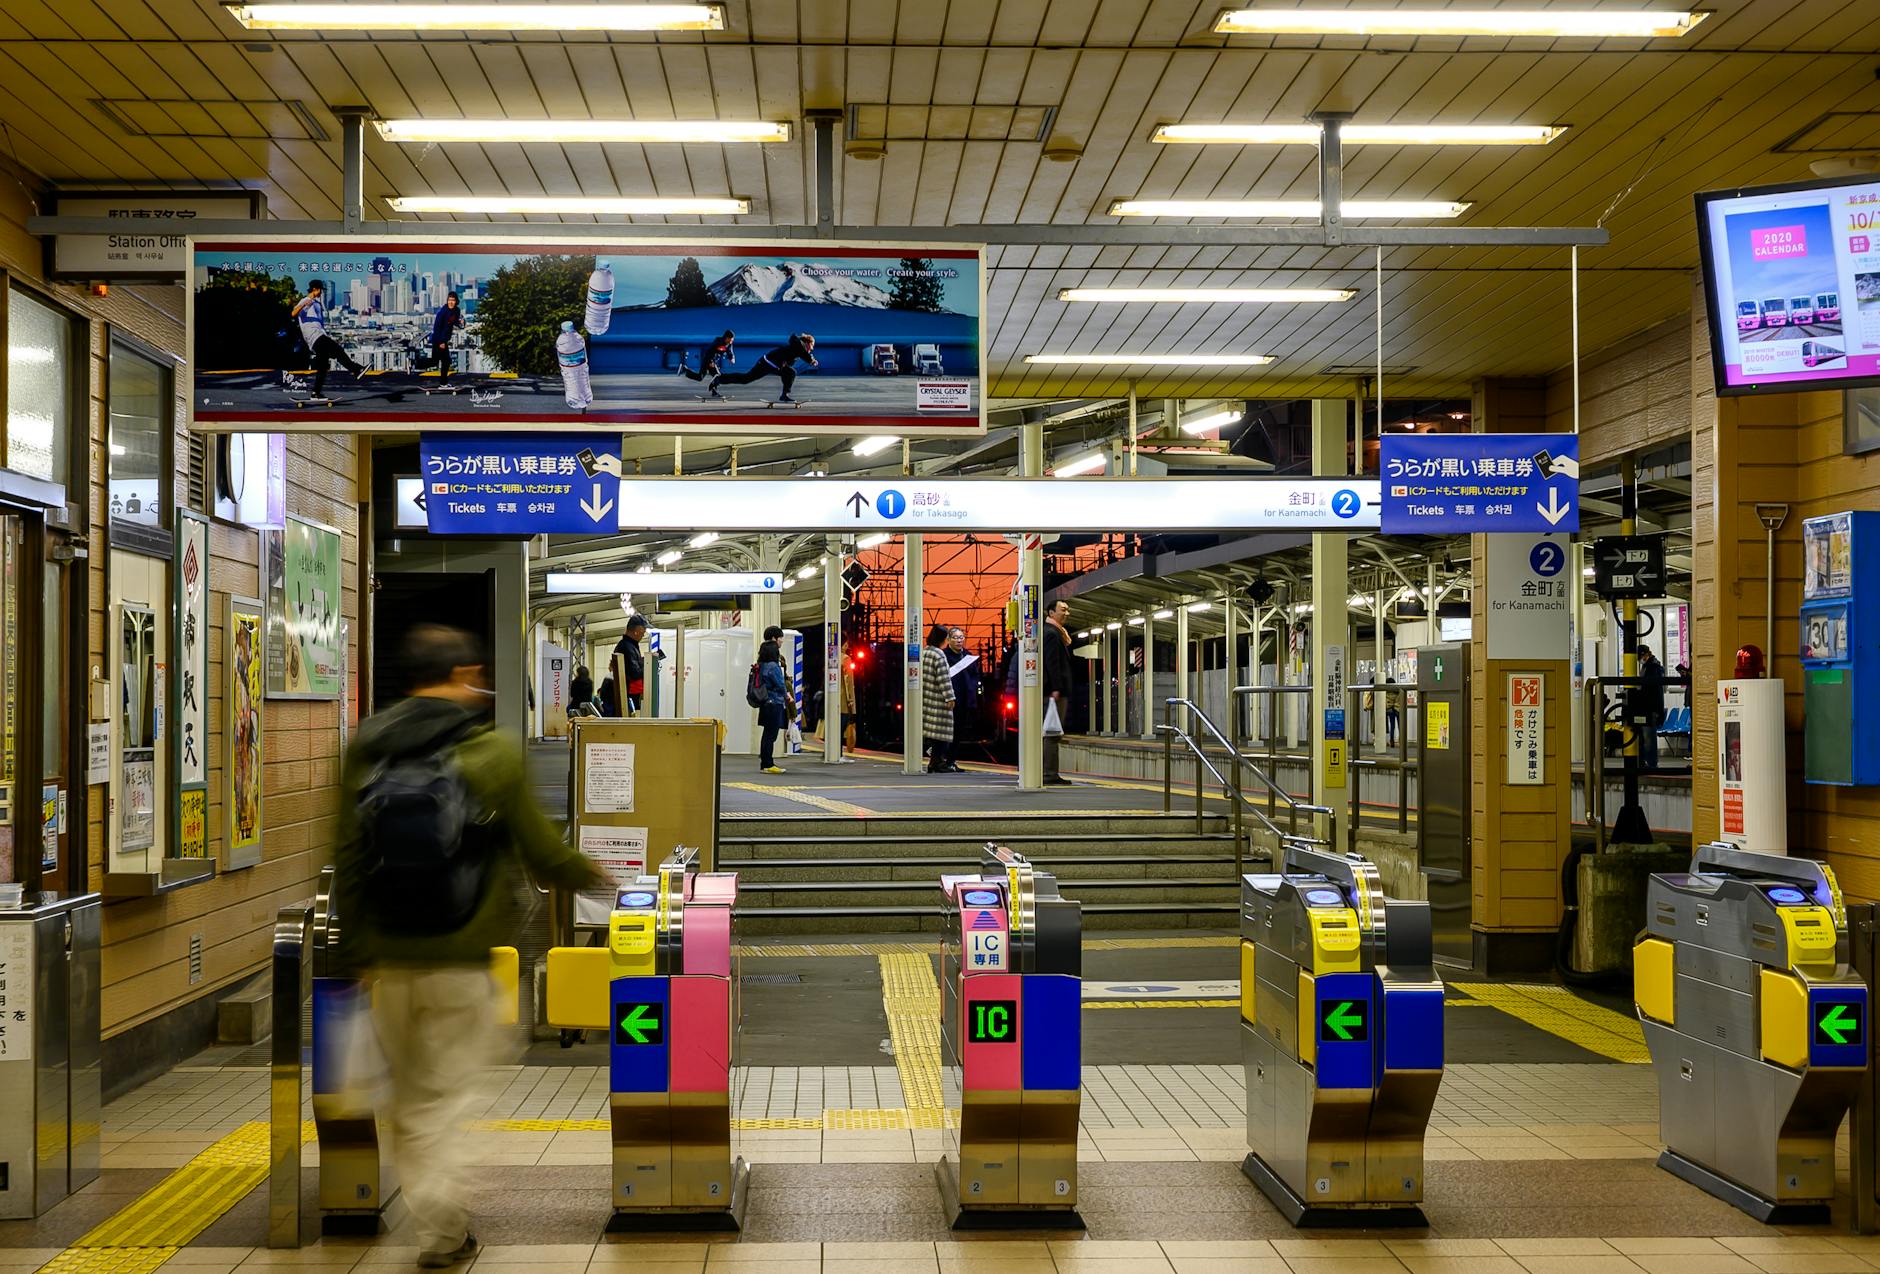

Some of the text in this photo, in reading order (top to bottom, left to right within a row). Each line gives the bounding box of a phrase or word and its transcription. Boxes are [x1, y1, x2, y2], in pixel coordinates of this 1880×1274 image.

[1849, 210, 1880, 230] 10/
[108, 234, 155, 248] Station
[1763, 231, 1793, 245] 2020
[1754, 243, 1805, 257] CALENDAR
[801, 266, 959, 279] Choose your water, Create your style.
[920, 387, 943, 395] CRYSTAL
[427, 455, 577, 476] うらが黒い乗車券
[1387, 458, 1534, 478] うらが黒い乗車券
[450, 484, 572, 494] ICカードもご利用いただけます
[1409, 485, 1528, 496] ICカードもご利用いただけます
[912, 492, 940, 506] 高砂
[1288, 491, 1315, 506] 金町
[448, 502, 486, 514] Tickets
[527, 502, 555, 514] 승차권
[912, 508, 968, 520] for Takasago
[1264, 508, 1326, 517] for Kanamachi
[1407, 504, 1445, 515] Tickets
[1485, 504, 1512, 515] 승차권
[1627, 551, 1648, 562] 下り
[1612, 575, 1633, 587] 上り
[1521, 580, 1565, 598] 金町 方面
[1492, 600, 1565, 611] for Kanamachi
[1514, 709, 1524, 750] 危険です
[1528, 709, 1538, 780] かけこみ乗車は
[975, 935, 999, 951] IC
[974, 953, 1000, 966] 専用
[12, 1009, 26, 1022] を
[976, 1005, 1008, 1038] IC
[973, 1182, 980, 1192] 2
[1059, 1182, 1065, 1192] 3
[1320, 1181, 1326, 1191] 3
[1405, 1179, 1411, 1190] 4
